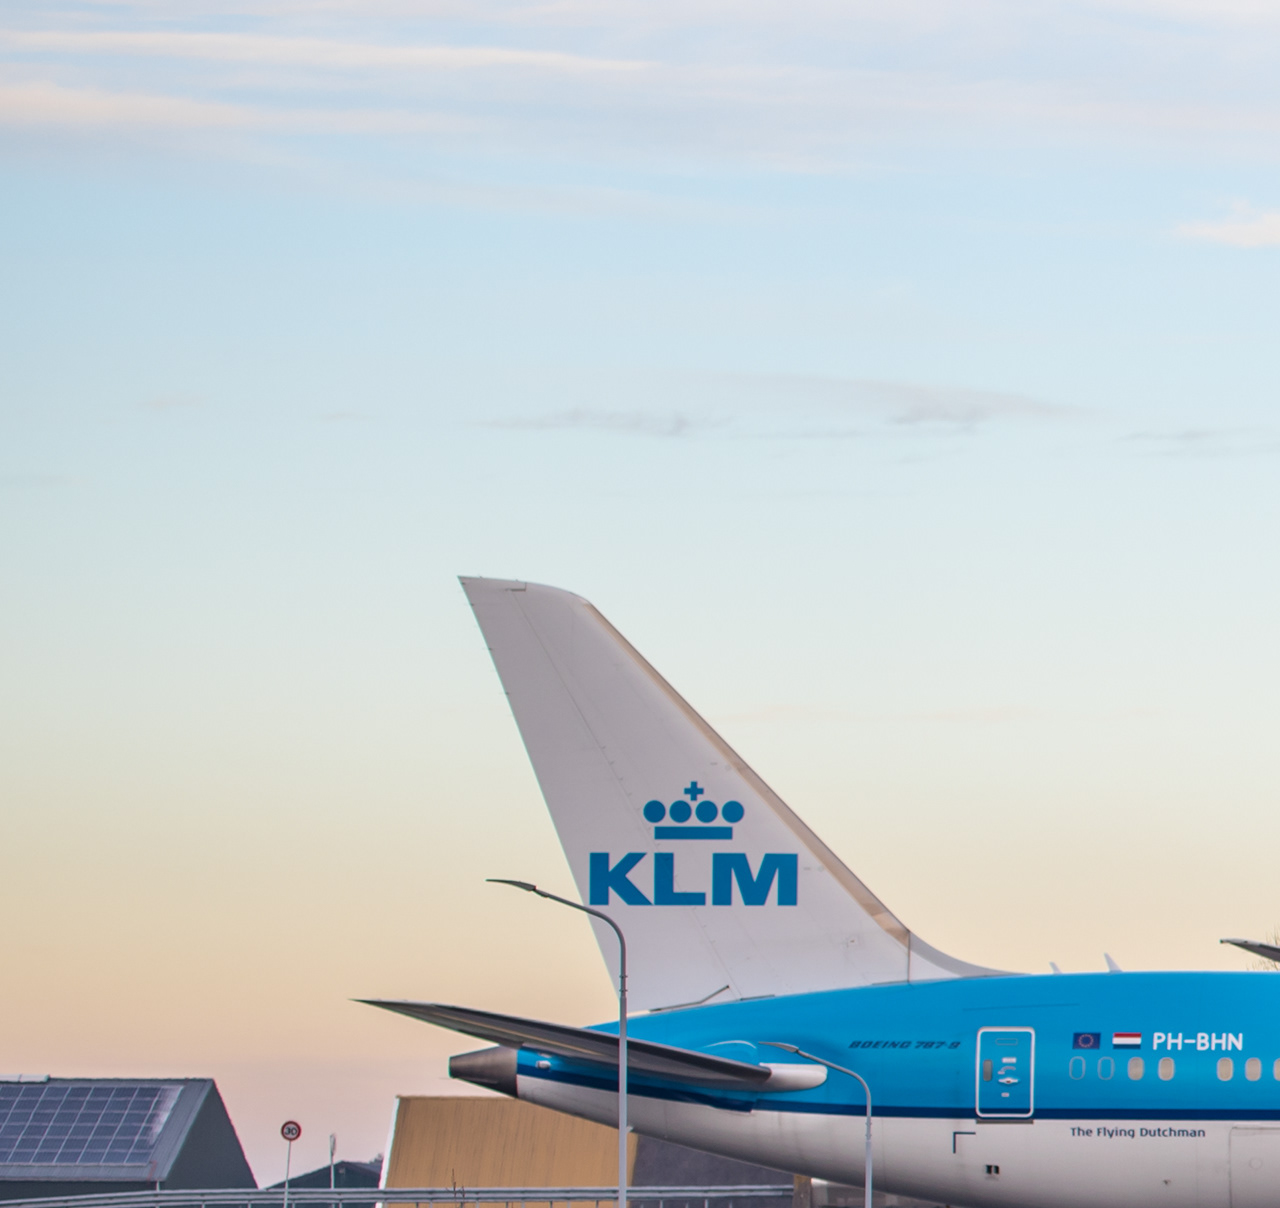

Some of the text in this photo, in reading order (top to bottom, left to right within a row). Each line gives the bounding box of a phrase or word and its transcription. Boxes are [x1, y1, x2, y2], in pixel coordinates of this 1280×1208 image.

[589, 852, 798, 906] KLM
[848, 1041, 961, 1050] BOEING 787-9
[1152, 1032, 1243, 1051] PH-BHN
[285, 1126, 298, 1136] 30
[1070, 1127, 1206, 1139] The Flying Dutchman
